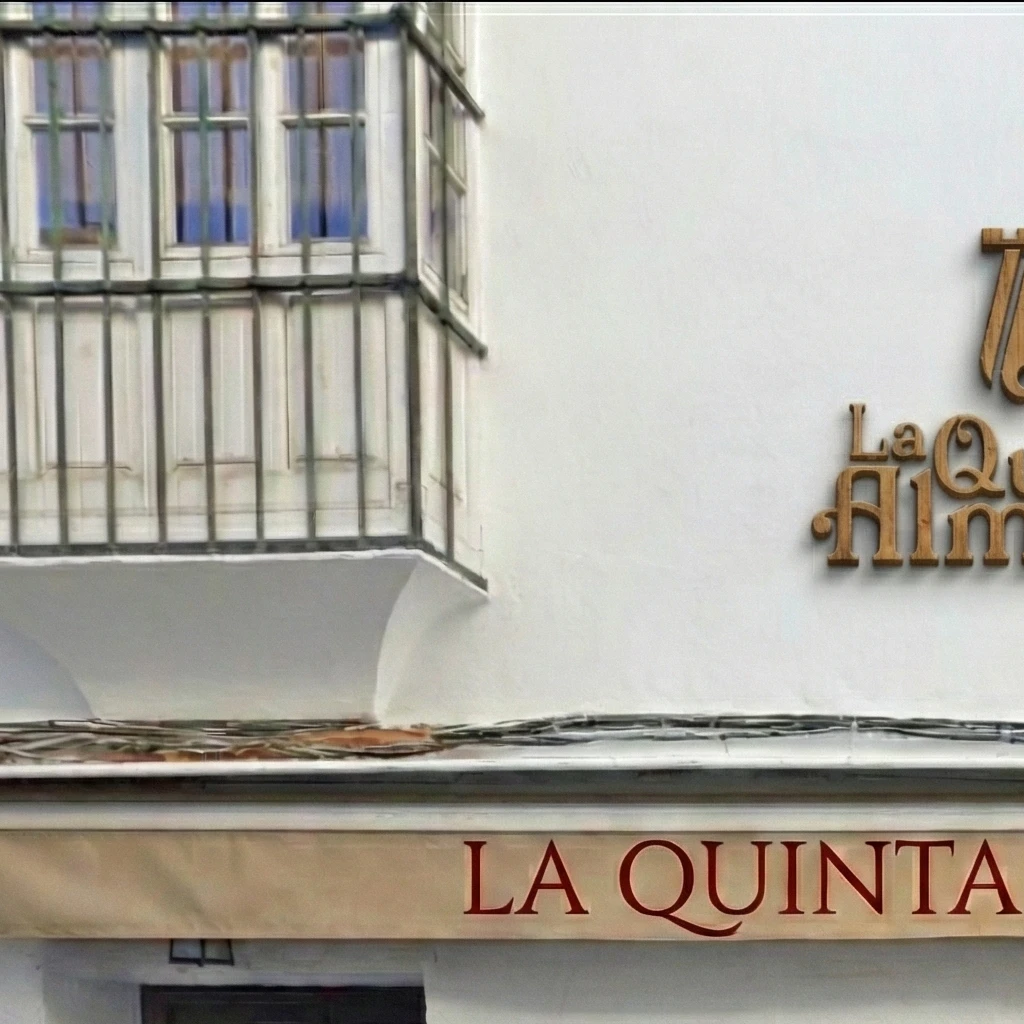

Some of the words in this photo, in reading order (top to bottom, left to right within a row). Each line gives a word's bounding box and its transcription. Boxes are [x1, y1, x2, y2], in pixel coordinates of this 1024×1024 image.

[849, 403, 926, 462] La
[463, 839, 589, 915] LA
[618, 838, 1022, 938] QUINTA
